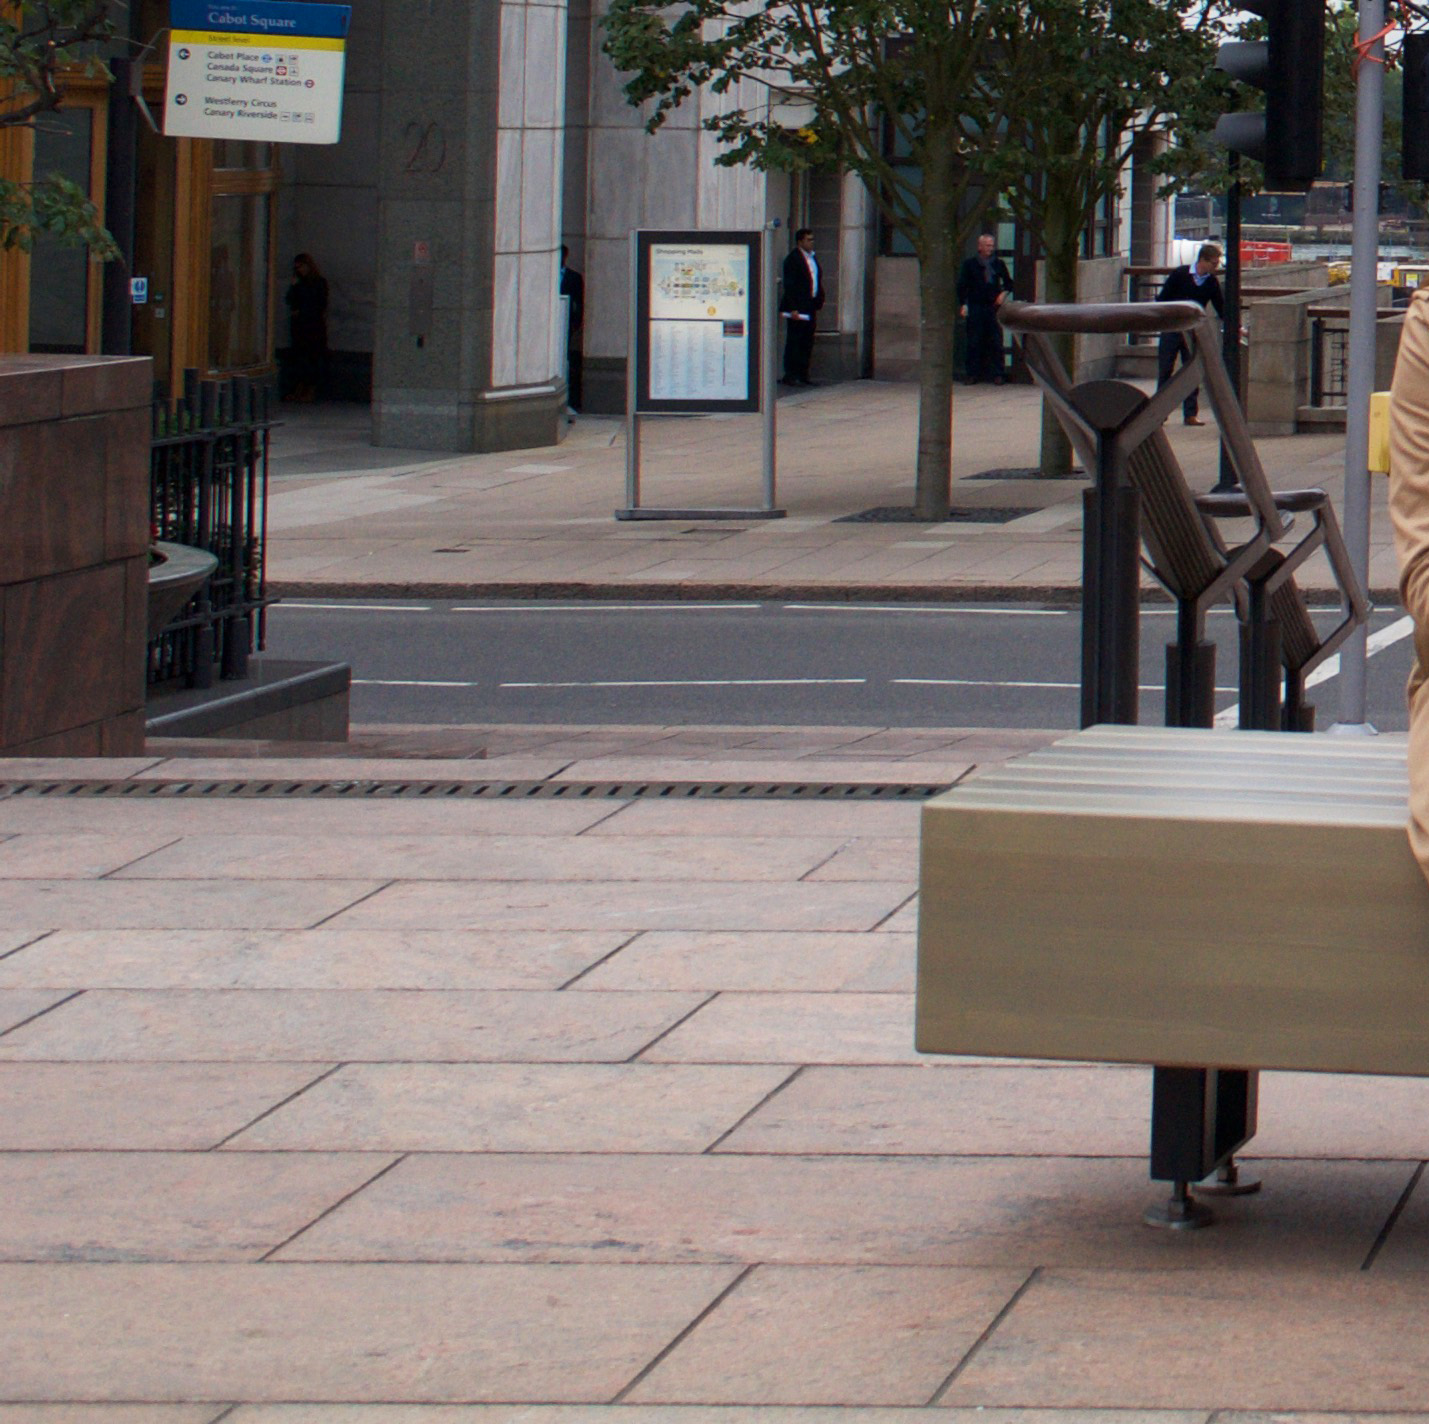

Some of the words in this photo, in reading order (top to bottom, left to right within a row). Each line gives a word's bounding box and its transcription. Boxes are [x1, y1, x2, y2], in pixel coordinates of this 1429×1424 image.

[208, 12, 248, 25] Cabot
[250, 14, 297, 30] Square
[207, 50, 234, 60] Cabot
[236, 52, 260, 62] Place
[207, 62, 240, 72] Canada
[242, 64, 273, 74] Square
[206, 73, 237, 84] Canary
[239, 75, 268, 84] Wharf
[270, 77, 302, 86] Station
[204, 96, 248, 108] Westferry
[250, 98, 278, 108] Circus
[204, 107, 235, 119] Canary
[237, 109, 278, 120] Riverside
[656, 248, 686, 256] Shopping
